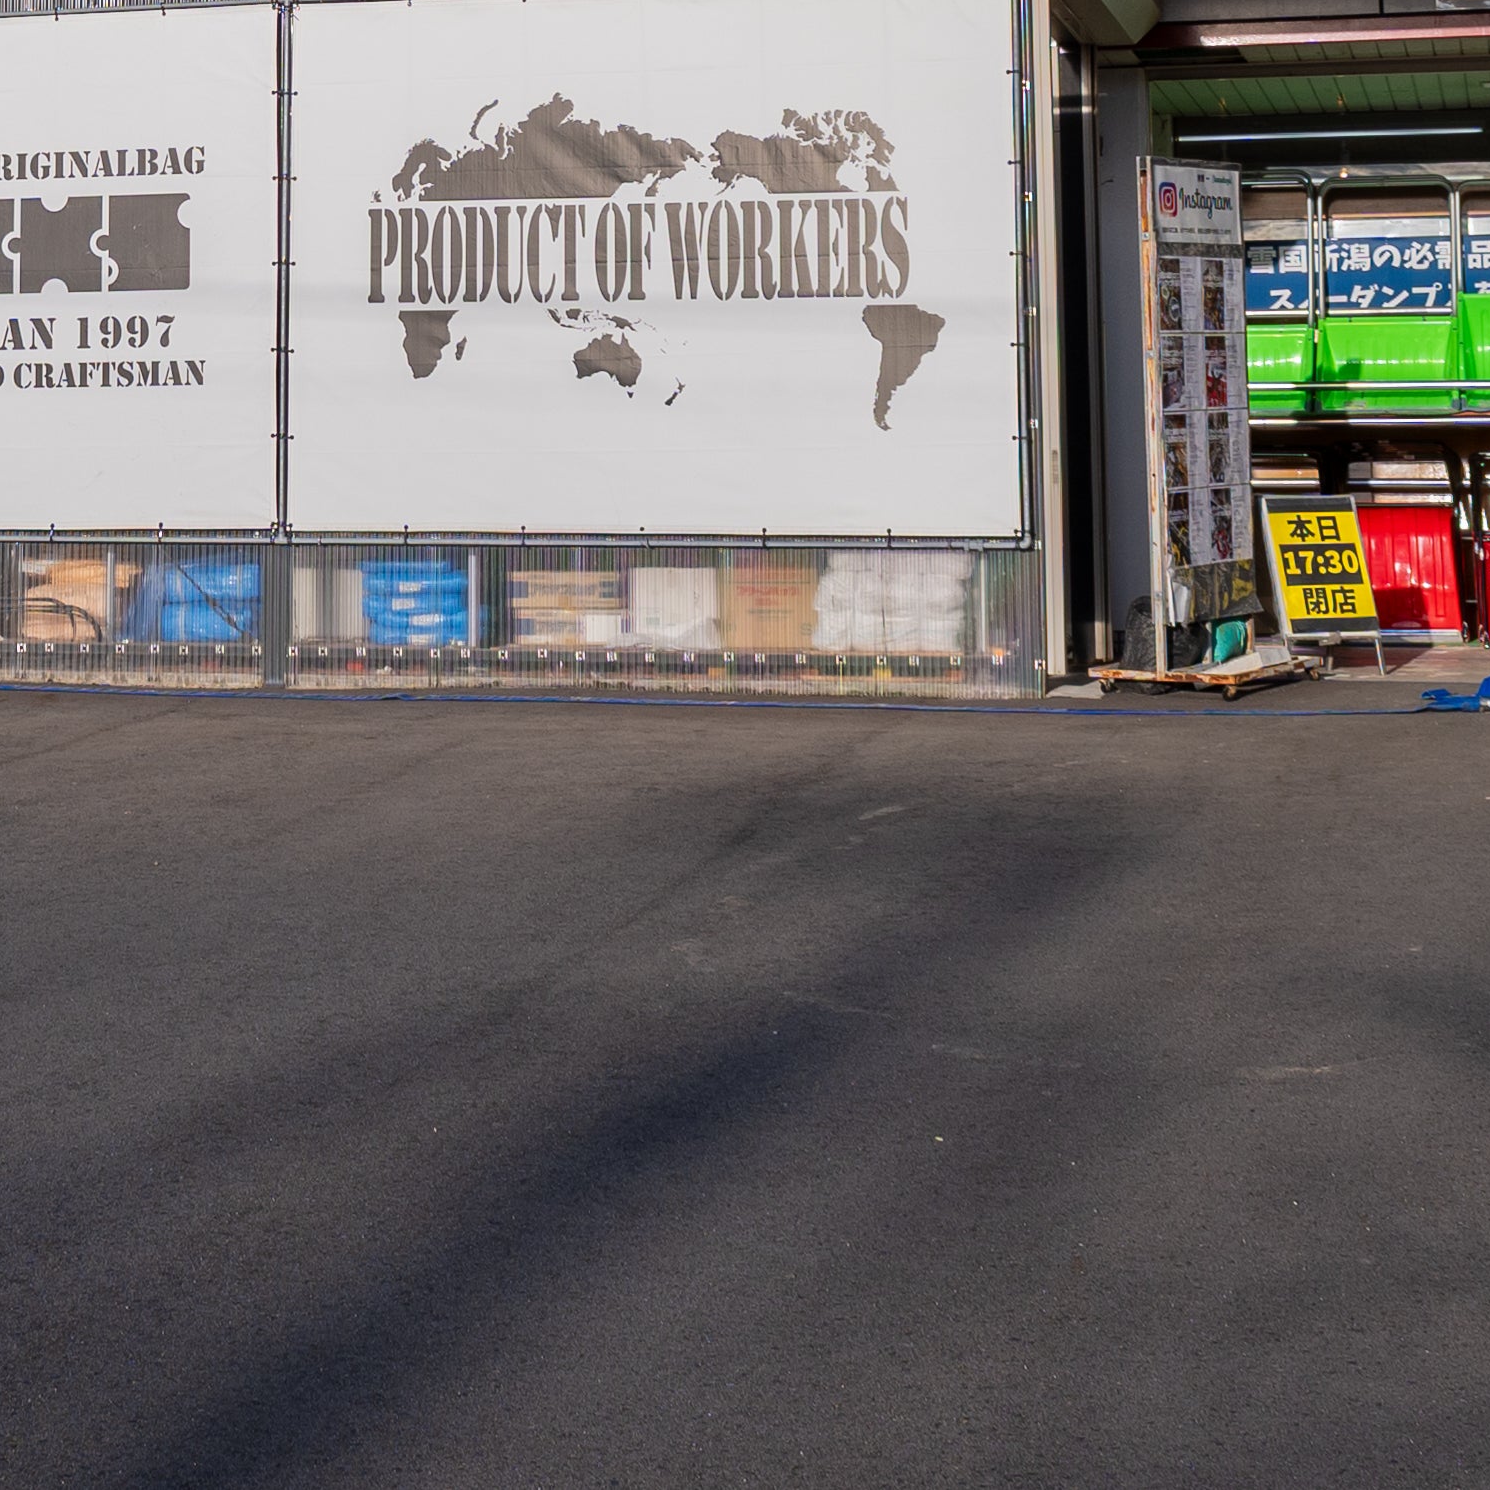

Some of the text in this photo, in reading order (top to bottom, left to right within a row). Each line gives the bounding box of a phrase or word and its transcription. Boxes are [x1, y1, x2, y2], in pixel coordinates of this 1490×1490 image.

[1179, 187, 1233, 220] Instagram
[367, 195, 911, 305] PRODUCT OF WORKERS
[76, 313, 176, 350] 1997
[12, 360, 207, 390] CRAFTSMAN
[1286, 514, 1341, 542] 本日
[1283, 549, 1360, 575] 17:30
[1302, 585, 1358, 615] 閉店
